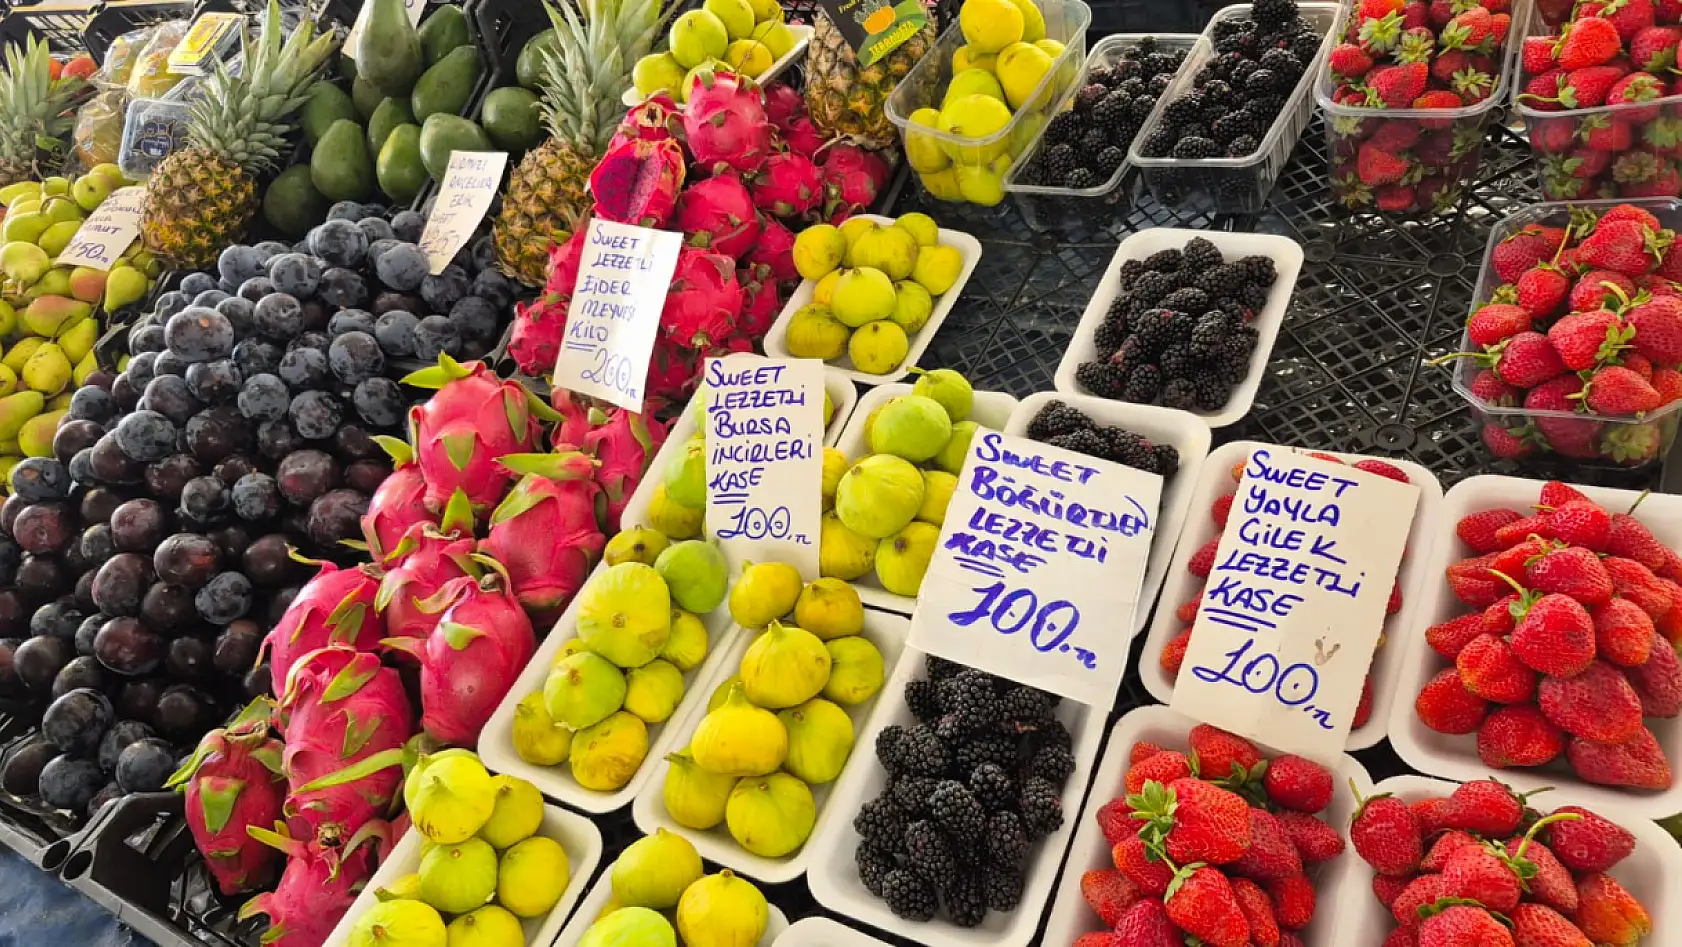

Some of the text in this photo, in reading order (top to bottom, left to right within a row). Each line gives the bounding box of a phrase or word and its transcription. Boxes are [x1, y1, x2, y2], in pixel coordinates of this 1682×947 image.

[592, 223, 640, 250] SWEET
[706, 359, 786, 388] SWEET
[713, 410, 791, 439] BURSA
[976, 433, 1101, 485] SWEET
[1246, 450, 1360, 498] SWEET
[709, 467, 765, 493] KASE
[1243, 484, 1341, 527] YAYLA
[944, 532, 1048, 573] KASE
[1208, 576, 1305, 617] KASE
